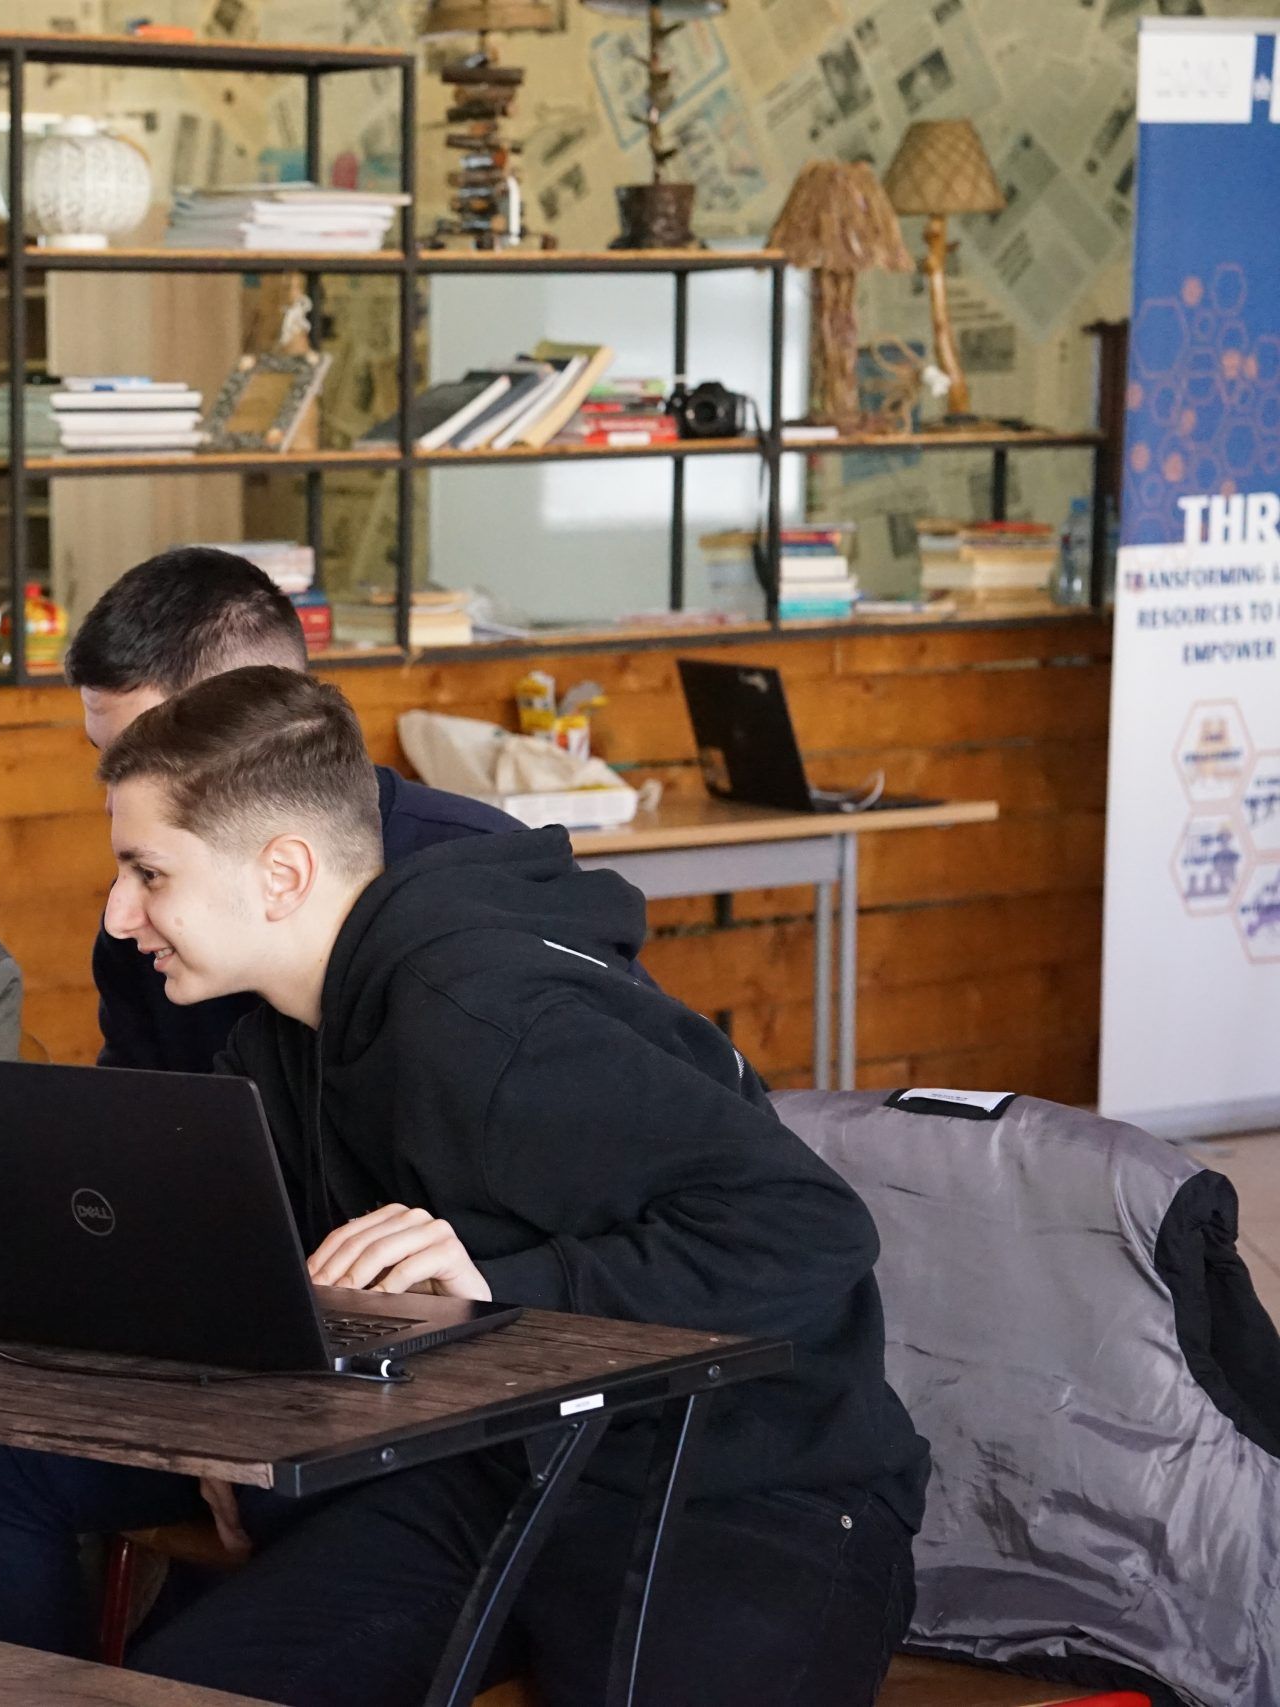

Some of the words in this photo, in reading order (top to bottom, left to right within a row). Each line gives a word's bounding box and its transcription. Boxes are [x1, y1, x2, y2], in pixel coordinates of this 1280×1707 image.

[1124, 565, 1266, 590] TRANSFORMING
[1137, 604, 1243, 631] RESOURCES
[1249, 601, 1273, 622] TO
[1183, 640, 1275, 666] EMPOWER
[76, 1204, 113, 1219] DELL
